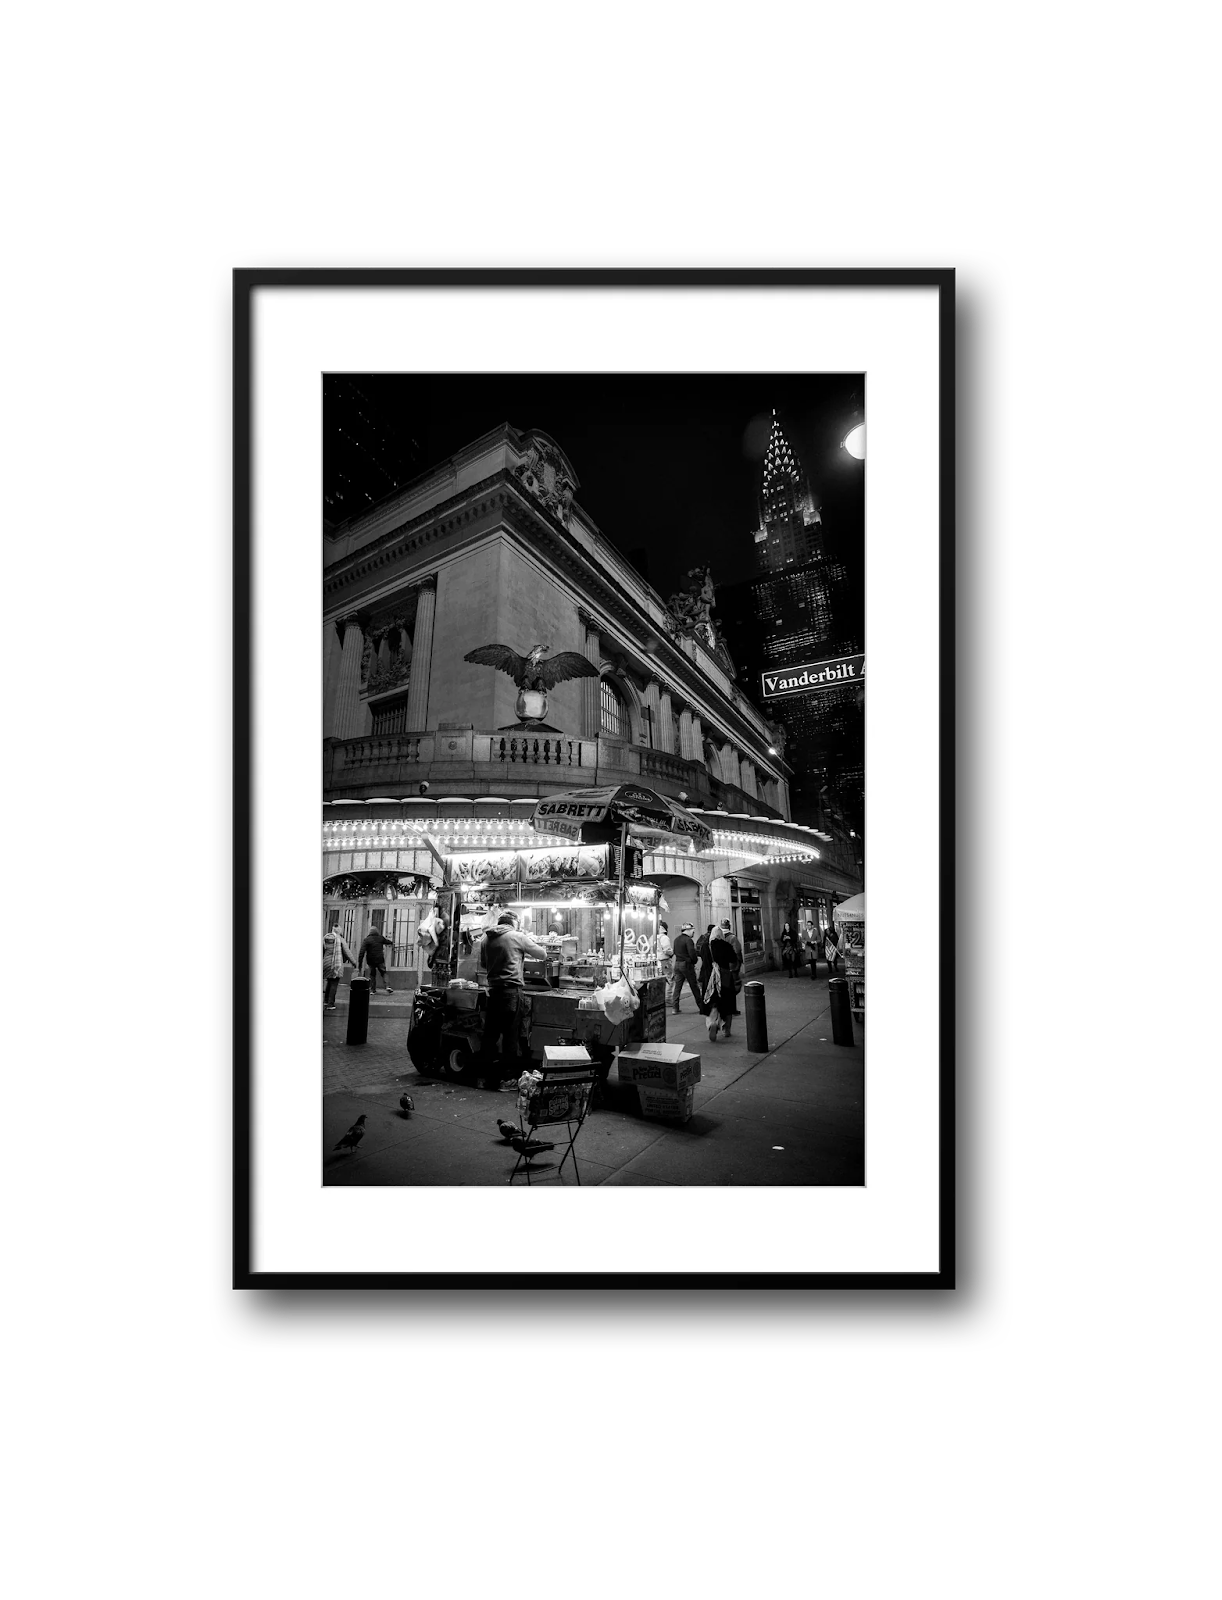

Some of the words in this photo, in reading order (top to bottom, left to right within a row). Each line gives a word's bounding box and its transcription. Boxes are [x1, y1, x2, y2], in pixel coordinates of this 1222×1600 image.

[765, 664, 855, 691] Vanderbilt
[538, 804, 606, 817] SABRETT
[632, 1067, 662, 1080] Pretzel
